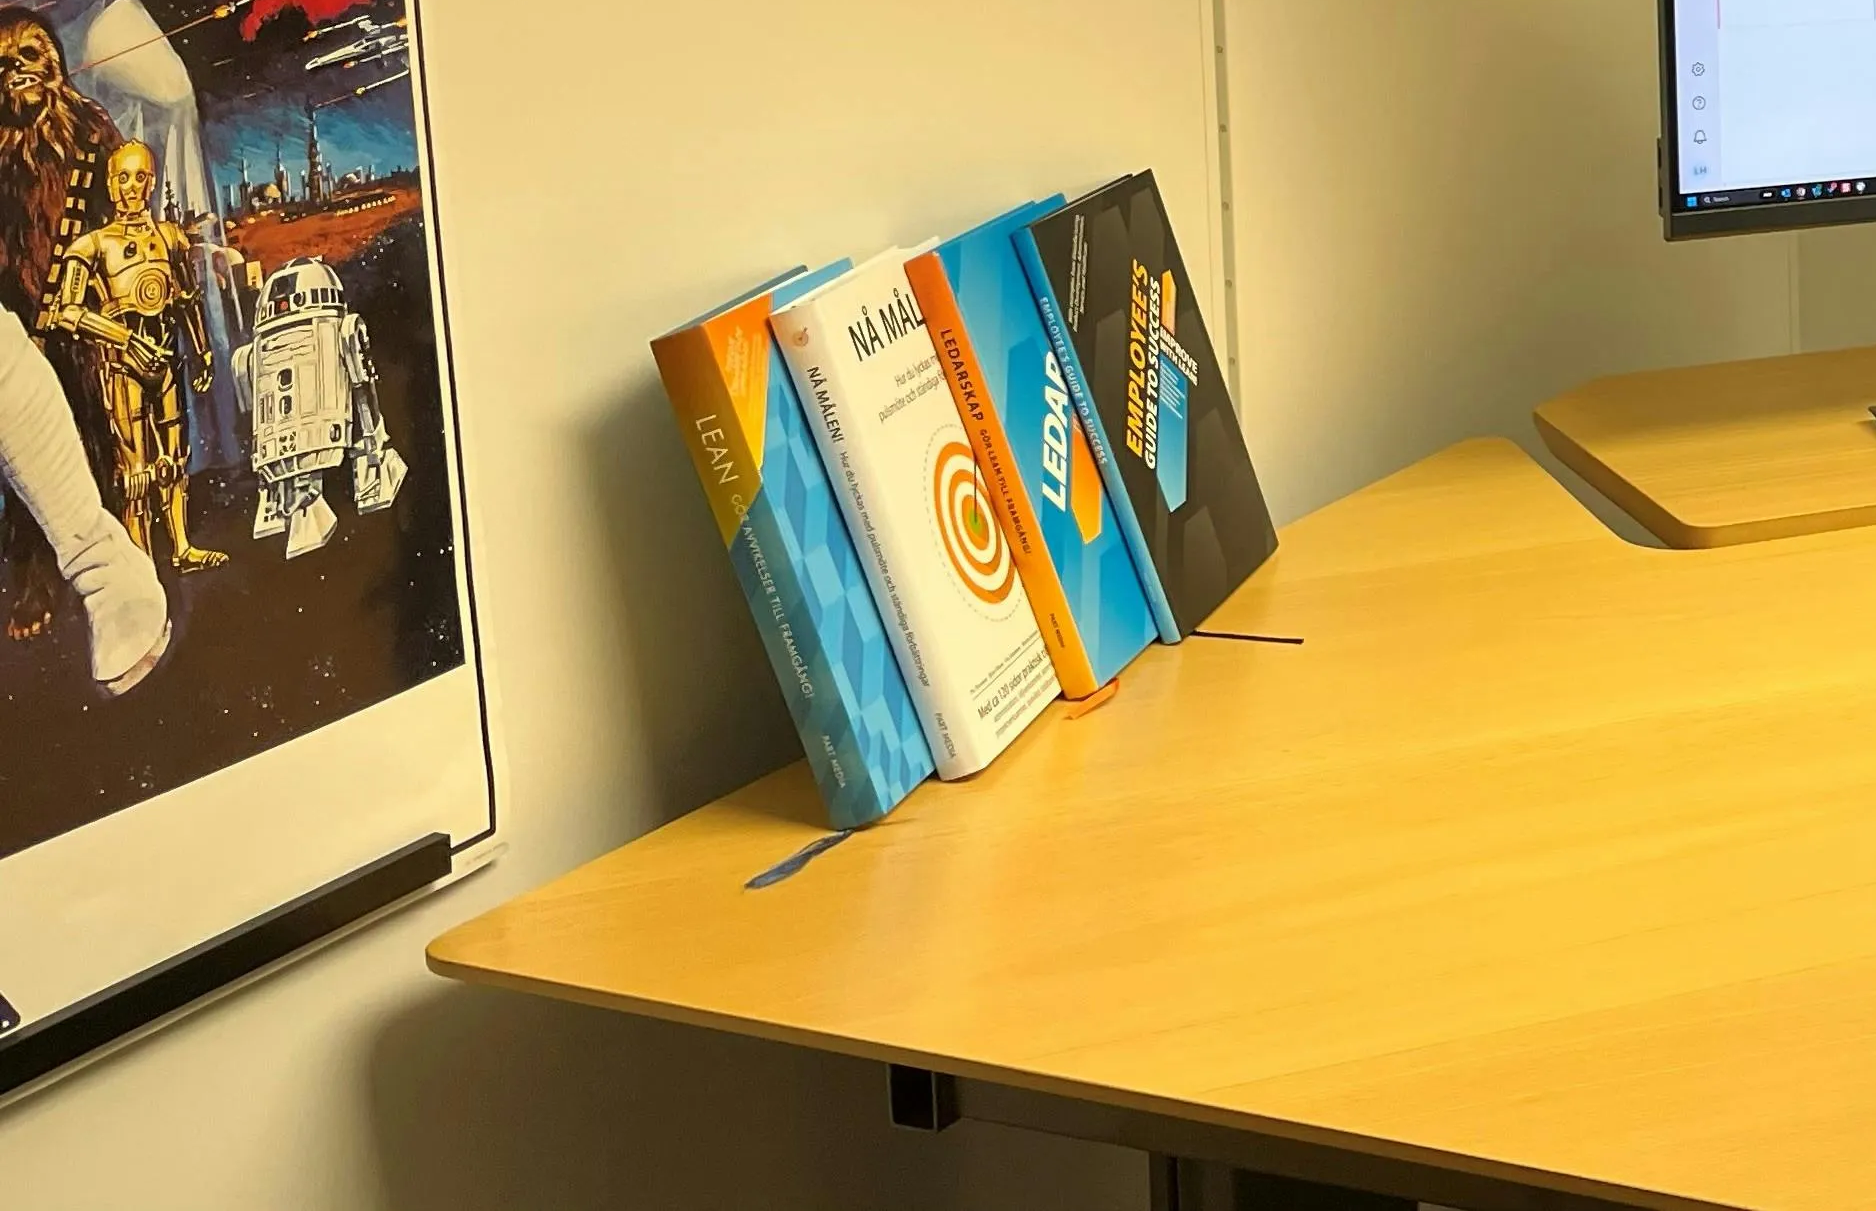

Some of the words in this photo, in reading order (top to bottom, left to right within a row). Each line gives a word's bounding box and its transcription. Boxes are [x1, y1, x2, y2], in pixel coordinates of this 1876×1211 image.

[1693, 166, 1707, 176] LH
[847, 305, 885, 362] NÅ
[1126, 258, 1149, 458] EMPLOYEE'S
[1148, 276, 1161, 368] SUCCESS
[1159, 325, 1198, 374] IMPROVE
[940, 328, 985, 421] LEDARSKAP
[979, 428, 992, 450] GÖR
[998, 475, 1009, 498] TILL
[1040, 296, 1070, 363] EMPLOYEE'S
[1065, 365, 1084, 400] GUIDE
[1078, 400, 1090, 416] TO
[1084, 418, 1109, 465] SUCCESS
[1146, 369, 1160, 399] TO
[807, 366, 827, 389] NÅ
[840, 450, 850, 469] Hur
[845, 470, 855, 484] du
[861, 512, 875, 534] med
[1144, 400, 1160, 470] GUIDE
[695, 414, 740, 485] LEAN
[742, 526, 777, 595] AVVIKELSER
[769, 596, 785, 621] TILL
